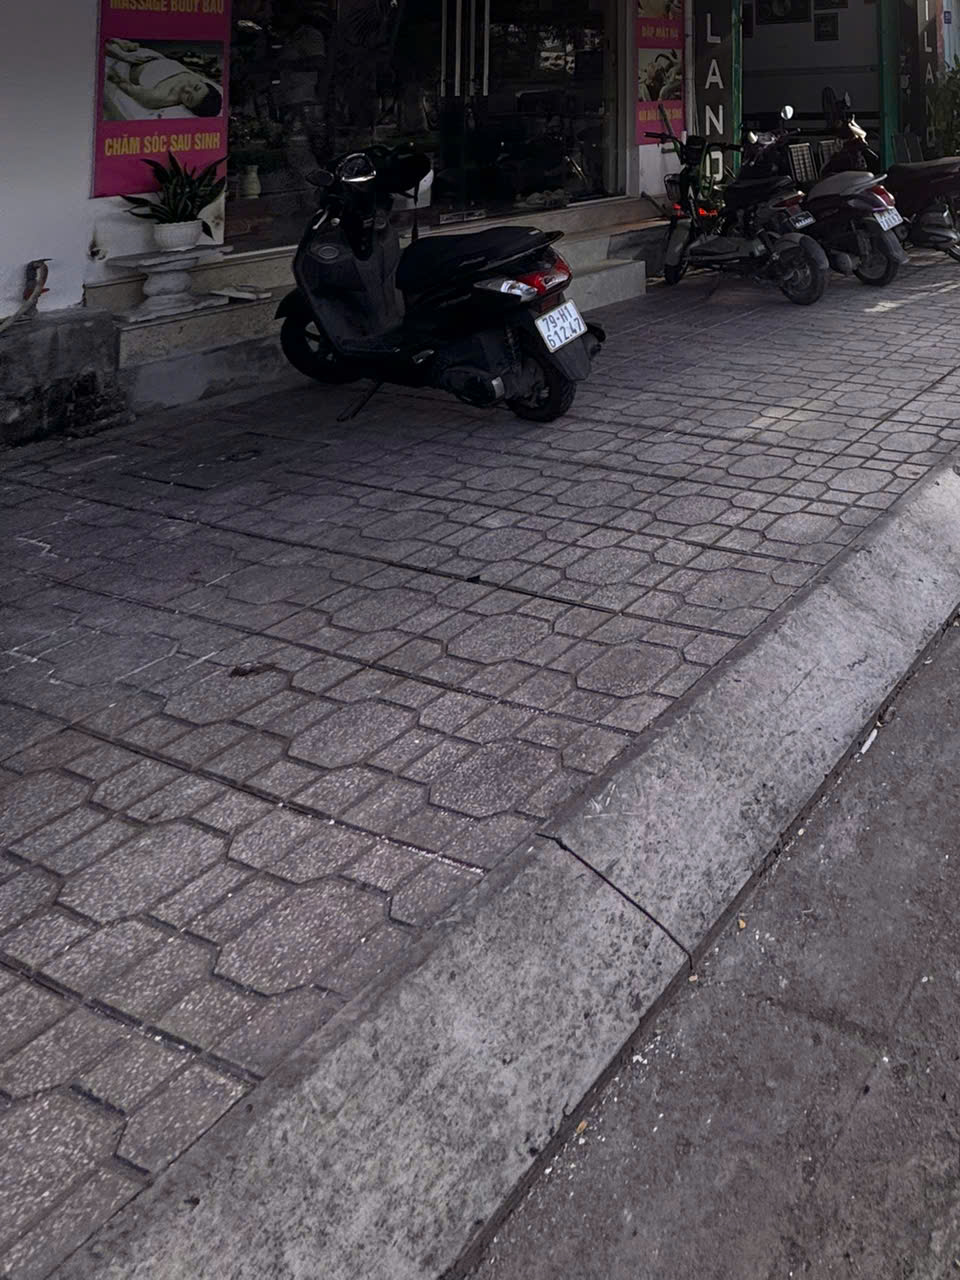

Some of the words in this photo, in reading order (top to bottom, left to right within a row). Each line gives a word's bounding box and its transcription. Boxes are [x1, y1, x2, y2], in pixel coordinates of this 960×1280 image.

[104, 133, 140, 156] CHĂM
[144, 131, 167, 153] SÓC
[170, 133, 192, 152] SAU
[194, 132, 220, 150] SINH
[542, 305, 573, 332] 79-H1
[546, 317, 582, 348] 612.47
